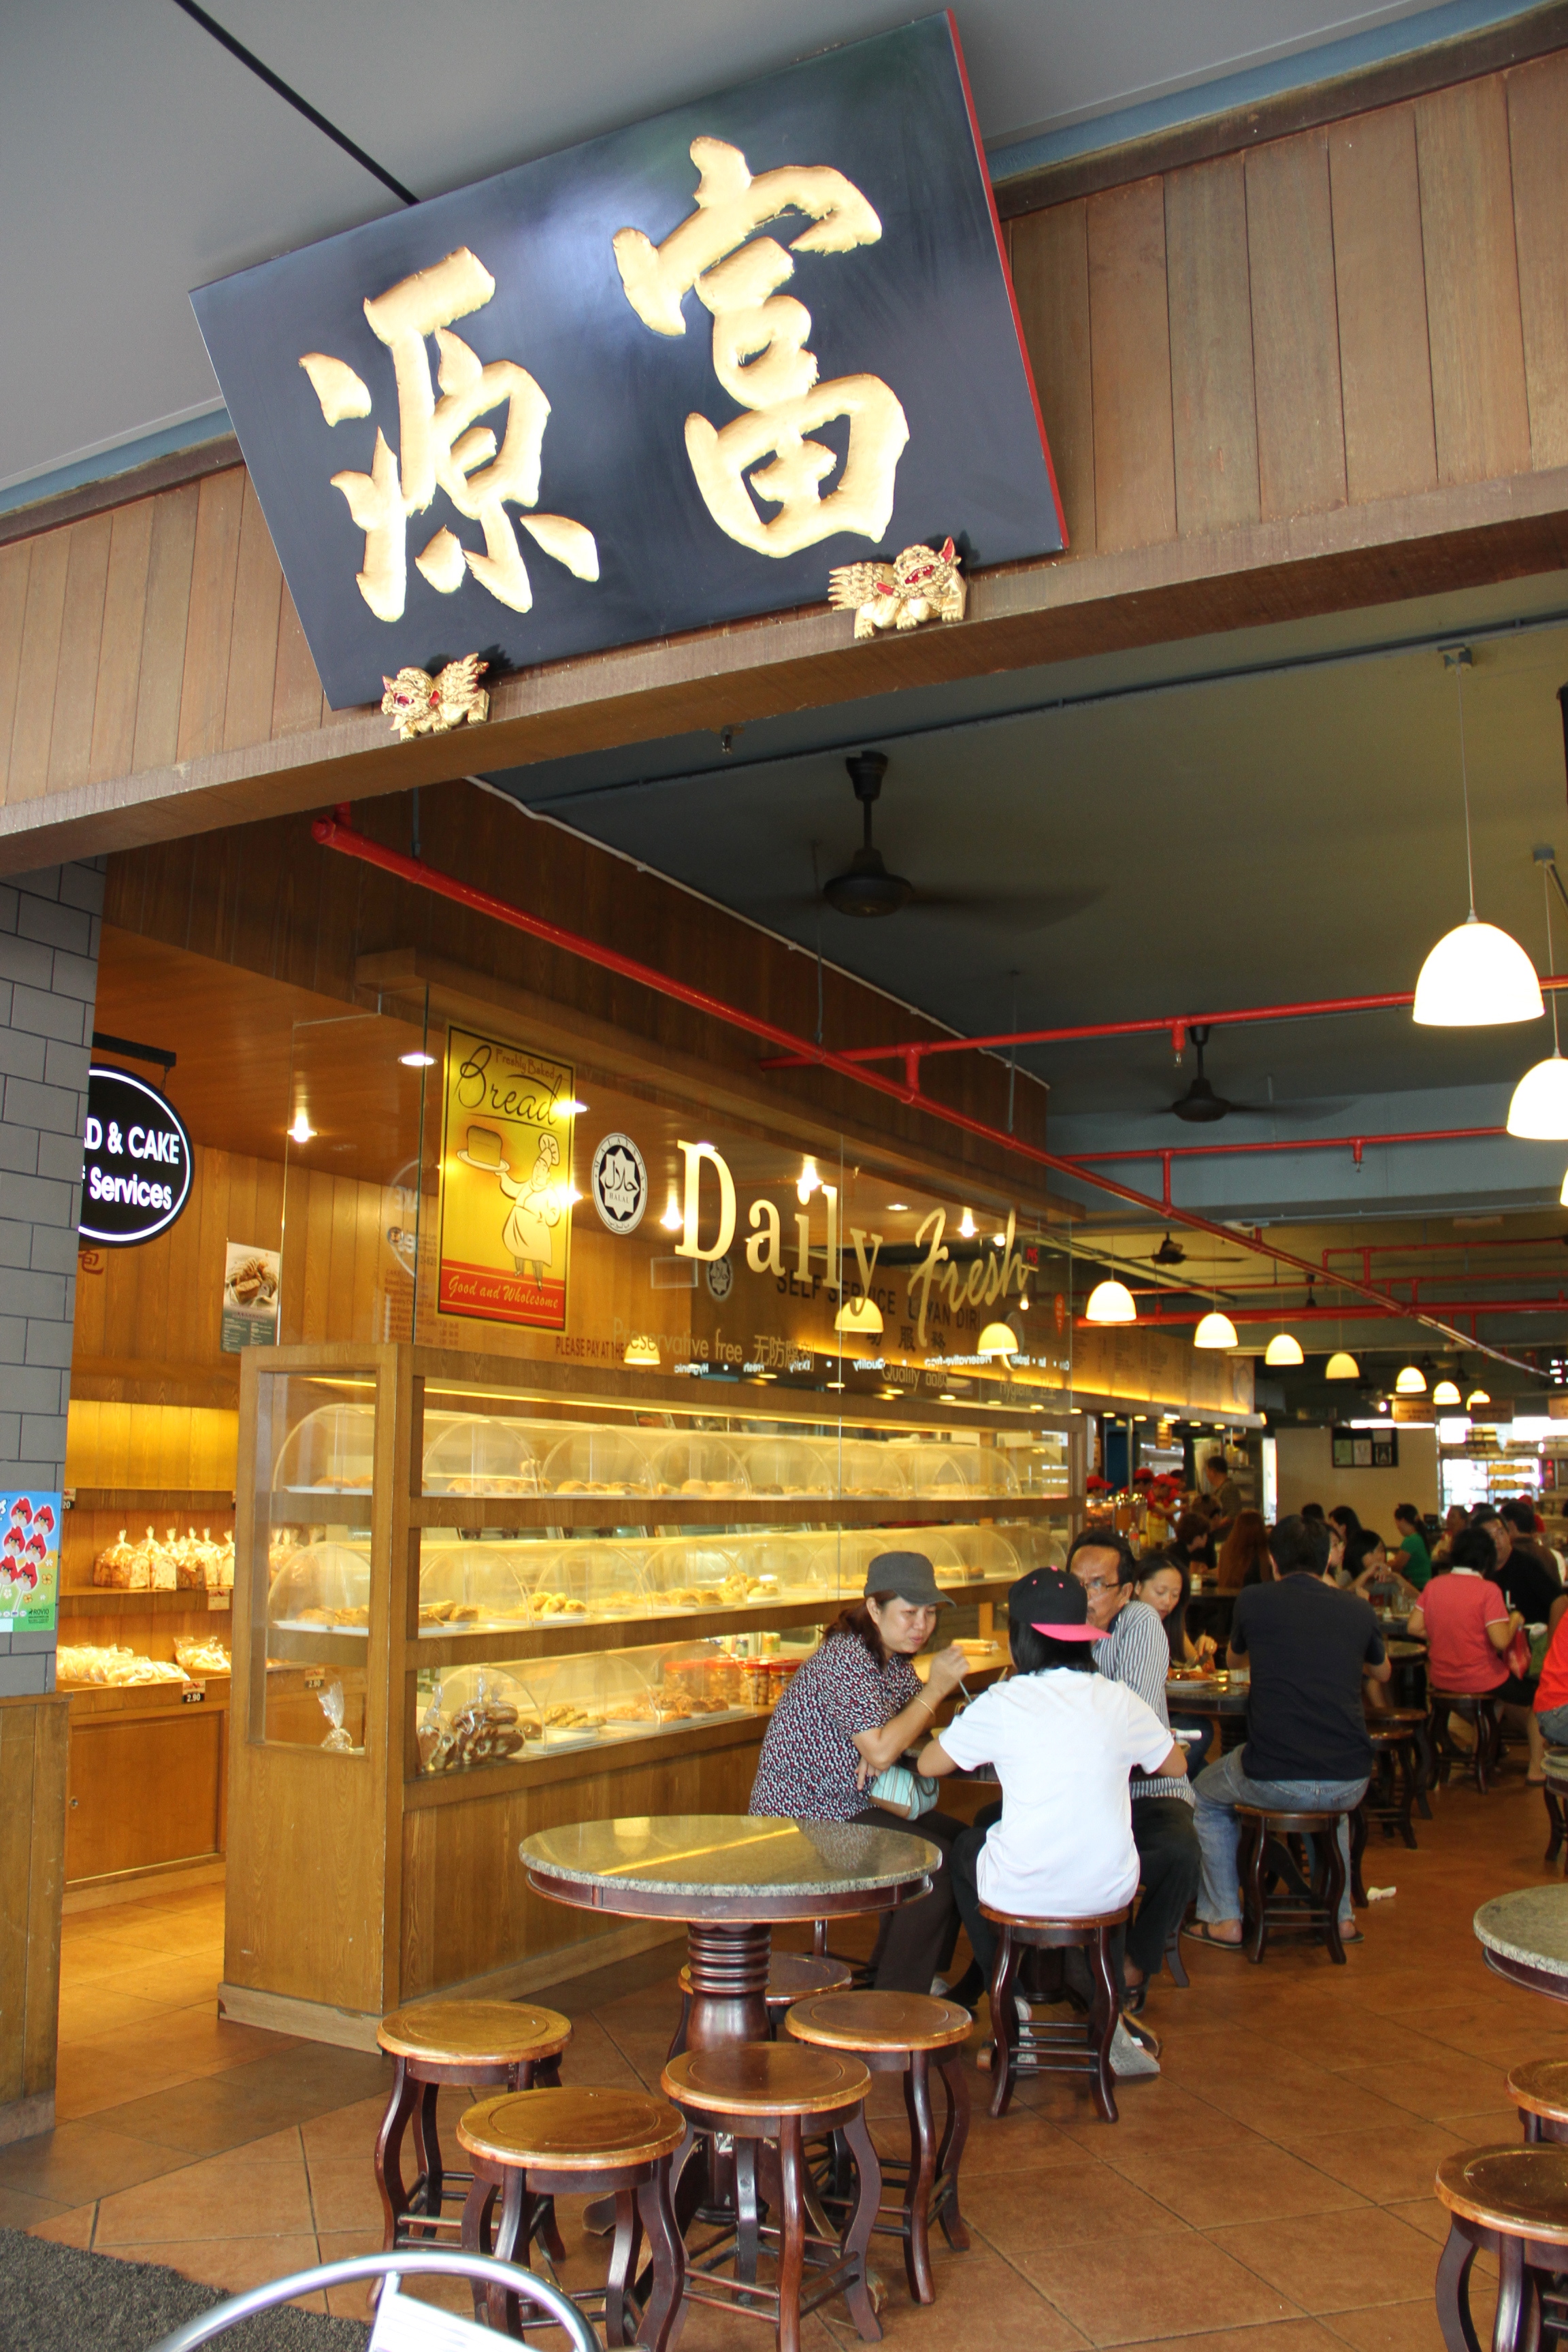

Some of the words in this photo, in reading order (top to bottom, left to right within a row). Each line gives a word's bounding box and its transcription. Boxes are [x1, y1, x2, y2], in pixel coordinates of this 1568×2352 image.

[495, 1048, 527, 1074] Freshly
[527, 1058, 555, 1079] Baked
[453, 1045, 562, 1125] Bread
[84, 1117, 102, 1150] D
[108, 1122, 123, 1154] &
[128, 1126, 180, 1164] CAKE
[89, 1166, 172, 1210] Services
[609, 1192, 630, 1204] HALAL
[674, 1139, 883, 1317] Daily
[907, 1207, 1029, 1348] Fresh
[448, 1275, 478, 1297] Good
[479, 1285, 501, 1299] and
[503, 1285, 559, 1309] Wholesome
[777, 1270, 821, 1299] SELF
[556, 1336, 585, 1357] PLEASE
[587, 1339, 600, 1359] PAY
[601, 1341, 610, 1359] AT
[614, 1318, 709, 1358] Preservative
[716, 1328, 742, 1362] free
[882, 1358, 920, 1392] Quality
[187, 1693, 201, 1702] 2.90
